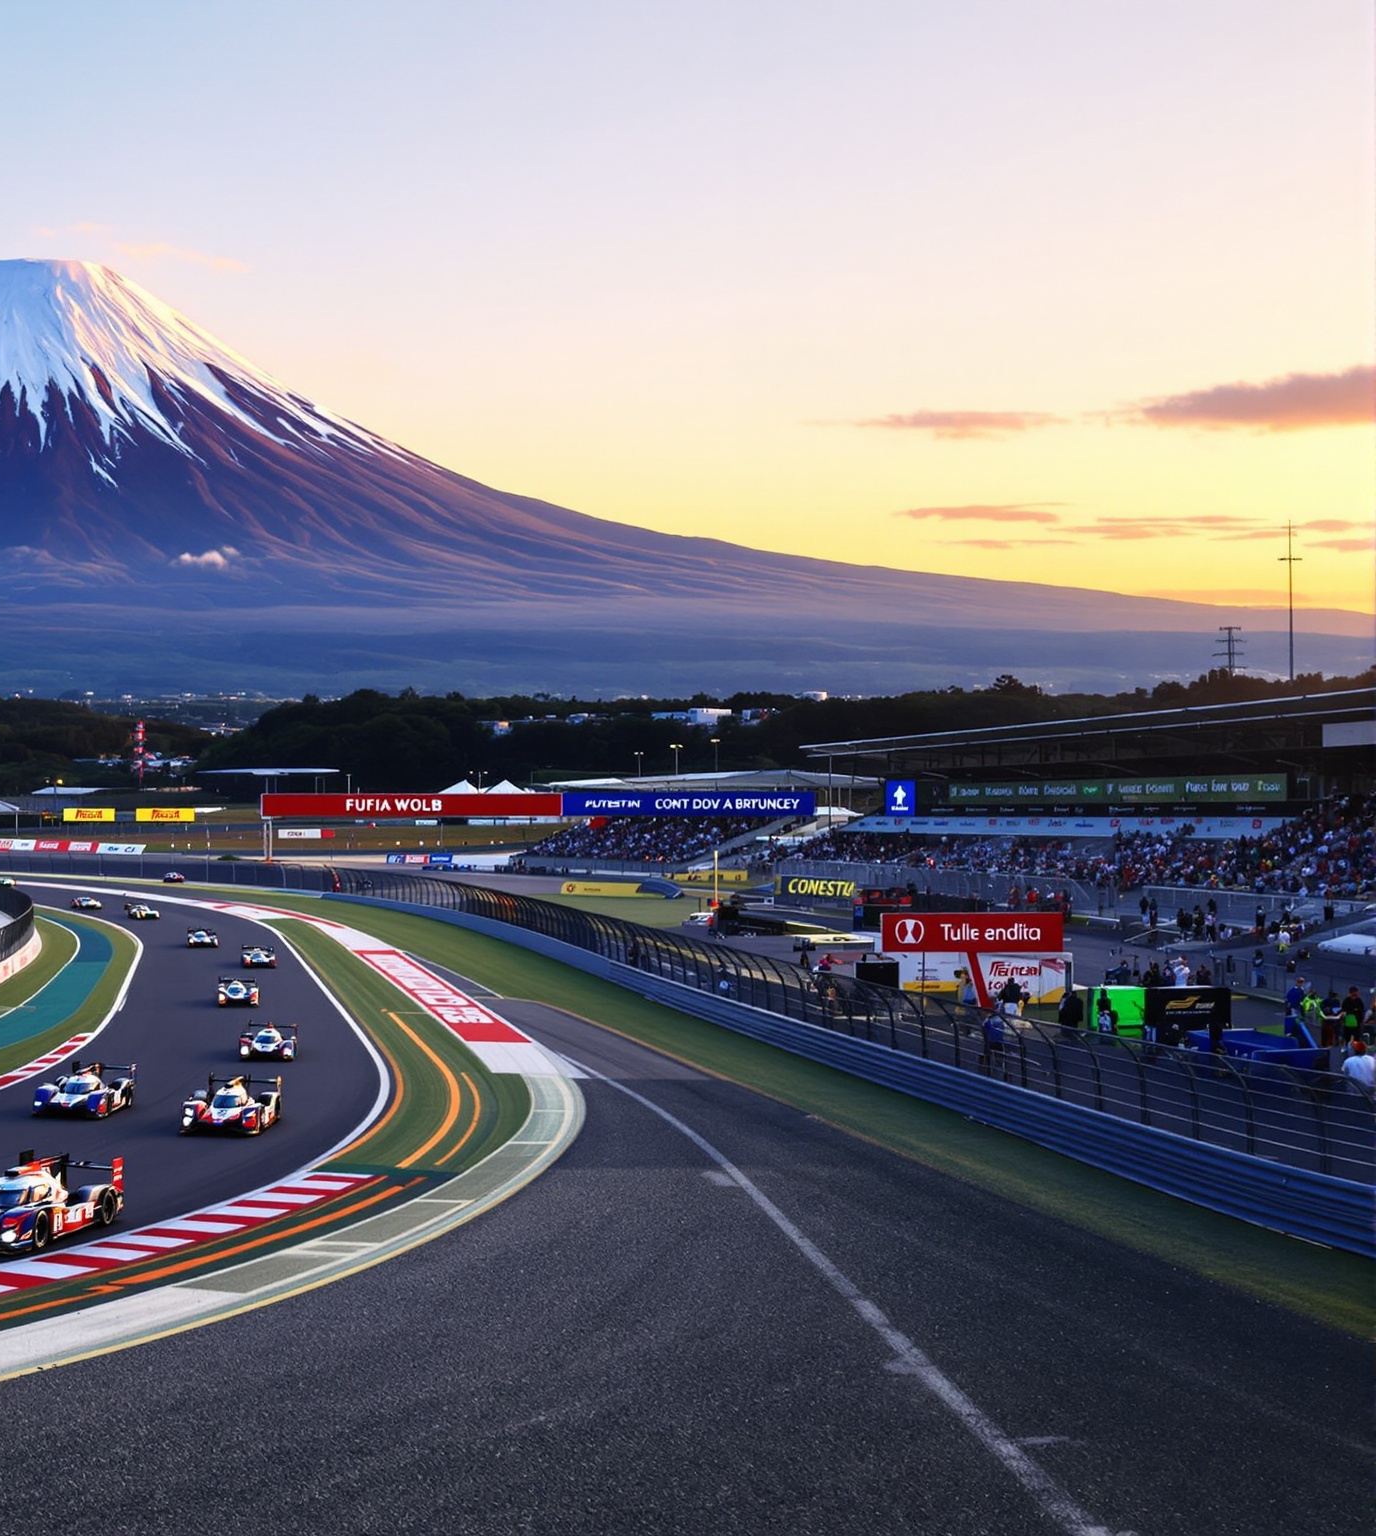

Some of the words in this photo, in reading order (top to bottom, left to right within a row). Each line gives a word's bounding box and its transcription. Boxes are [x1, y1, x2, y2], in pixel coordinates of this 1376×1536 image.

[345, 798, 391, 812] FUFIA
[655, 798, 689, 810] CONT
[692, 798, 720, 810] DOV
[722, 798, 733, 810] A
